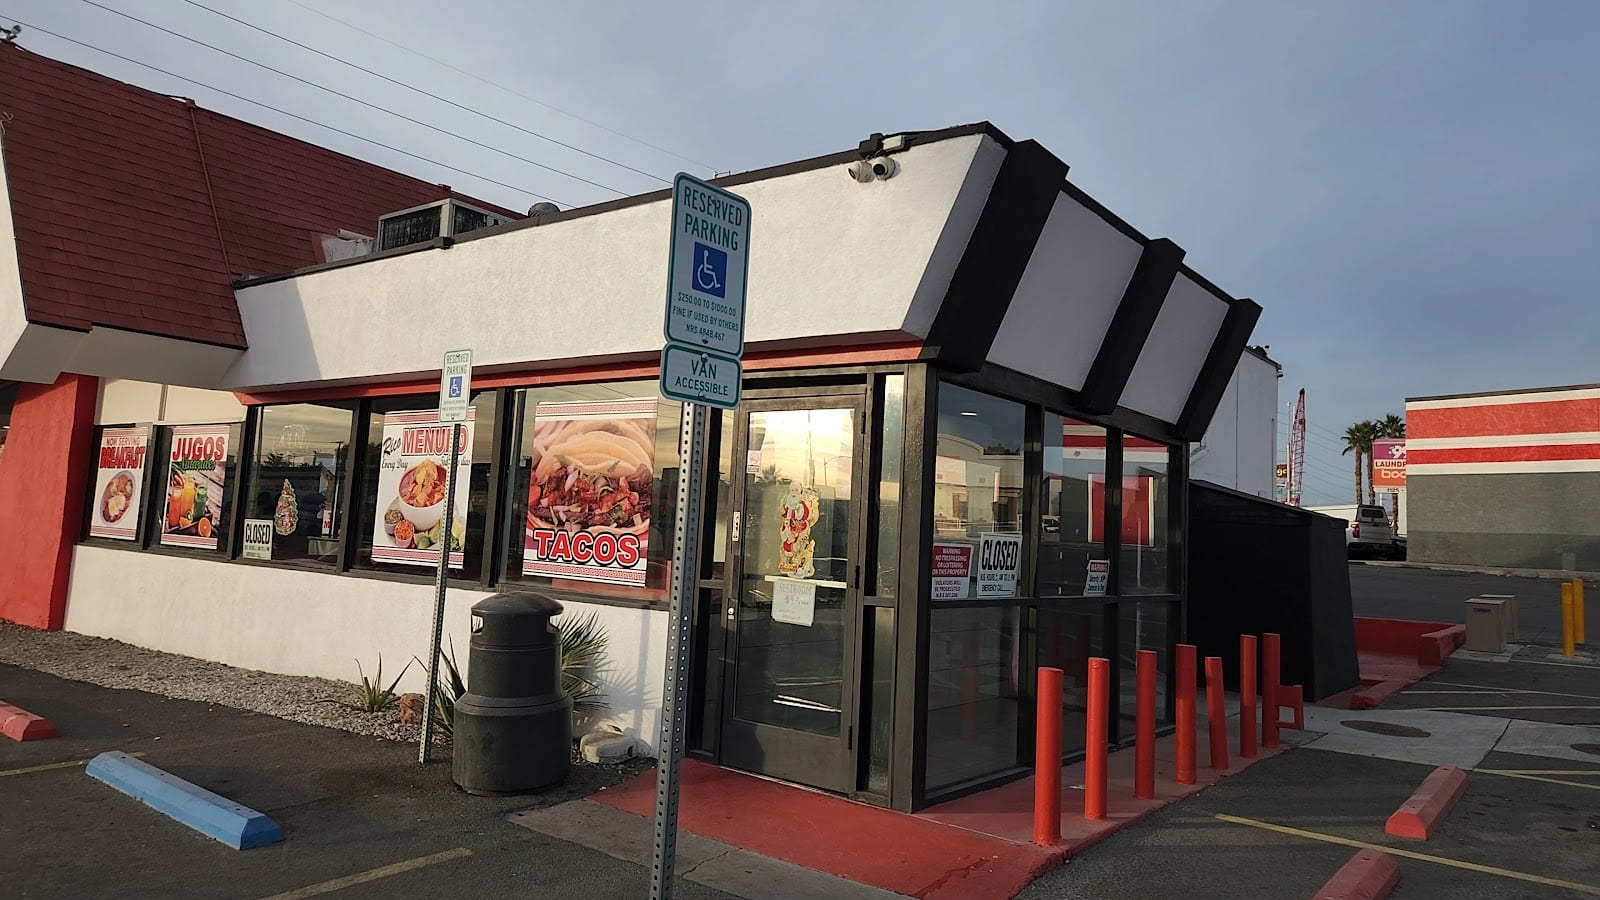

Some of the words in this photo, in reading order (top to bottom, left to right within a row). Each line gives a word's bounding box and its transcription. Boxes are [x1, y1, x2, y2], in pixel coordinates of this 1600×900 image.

[683, 186, 742, 226] RESERVED
[684, 213, 739, 251] PARKING
[678, 292, 701, 306] $250.00
[703, 299, 710, 309] TO
[711, 302, 737, 317] $1000.00
[672, 305, 686, 317] FINE
[687, 309, 693, 319] IF
[694, 312, 709, 323] USED
[710, 316, 717, 325] BY
[718, 319, 739, 332] OTHERS
[685, 323, 698, 334] NRS
[447, 365, 467, 375] PARKING
[691, 359, 717, 379] VAN
[674, 375, 729, 396] ACCESSIBLE
[172, 436, 225, 461] JUGOS
[382, 437, 401, 456] Rico
[402, 426, 468, 456] MENUO
[99, 445, 146, 469] BREAKFAST
[381, 458, 396, 472] Every
[396, 459, 409, 472] Day
[245, 523, 271, 545] CLOSED
[533, 529, 642, 567] TACOS
[982, 540, 1019, 570] CLOSED
